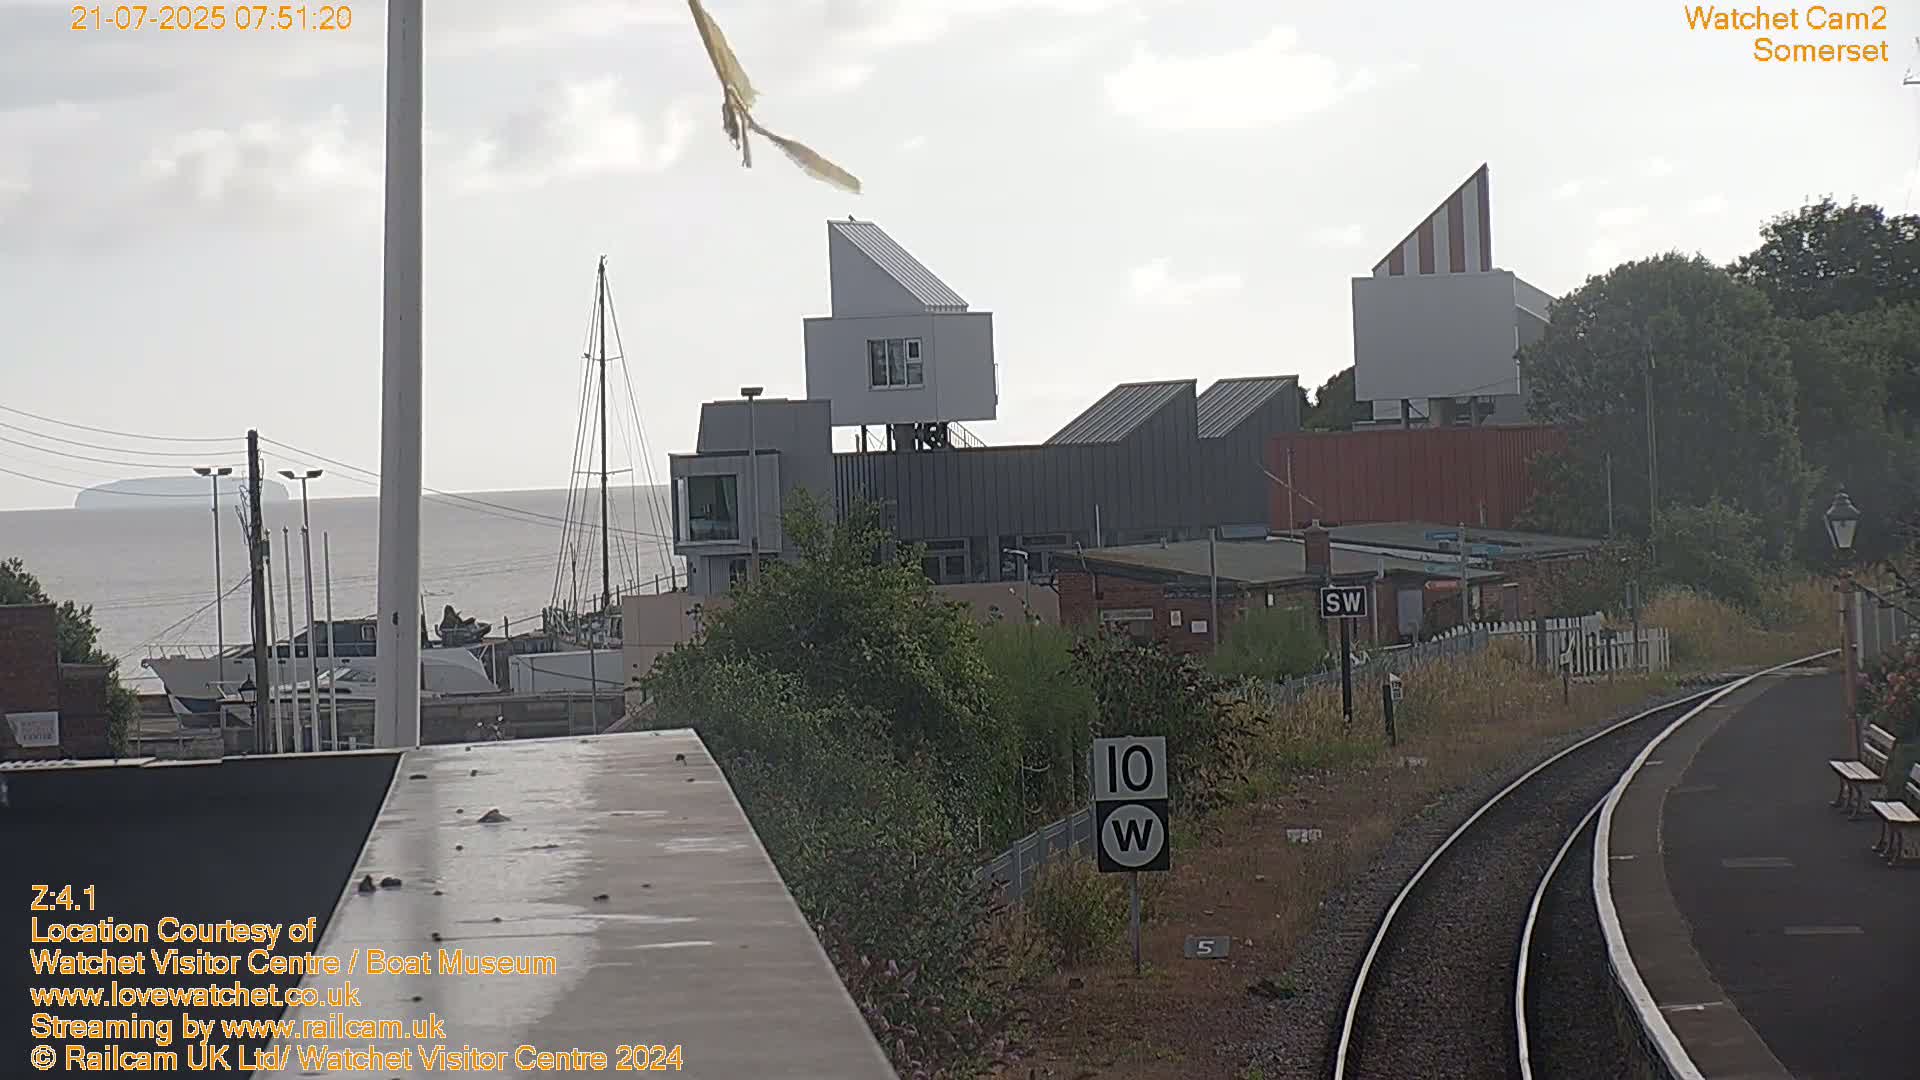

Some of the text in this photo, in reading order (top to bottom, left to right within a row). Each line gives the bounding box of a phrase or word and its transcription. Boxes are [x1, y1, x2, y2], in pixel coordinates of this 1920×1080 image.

[1326, 592, 1361, 613] SW
[1107, 744, 1154, 793] 10
[1111, 818, 1154, 852] W
[1196, 940, 1216, 955] 5
